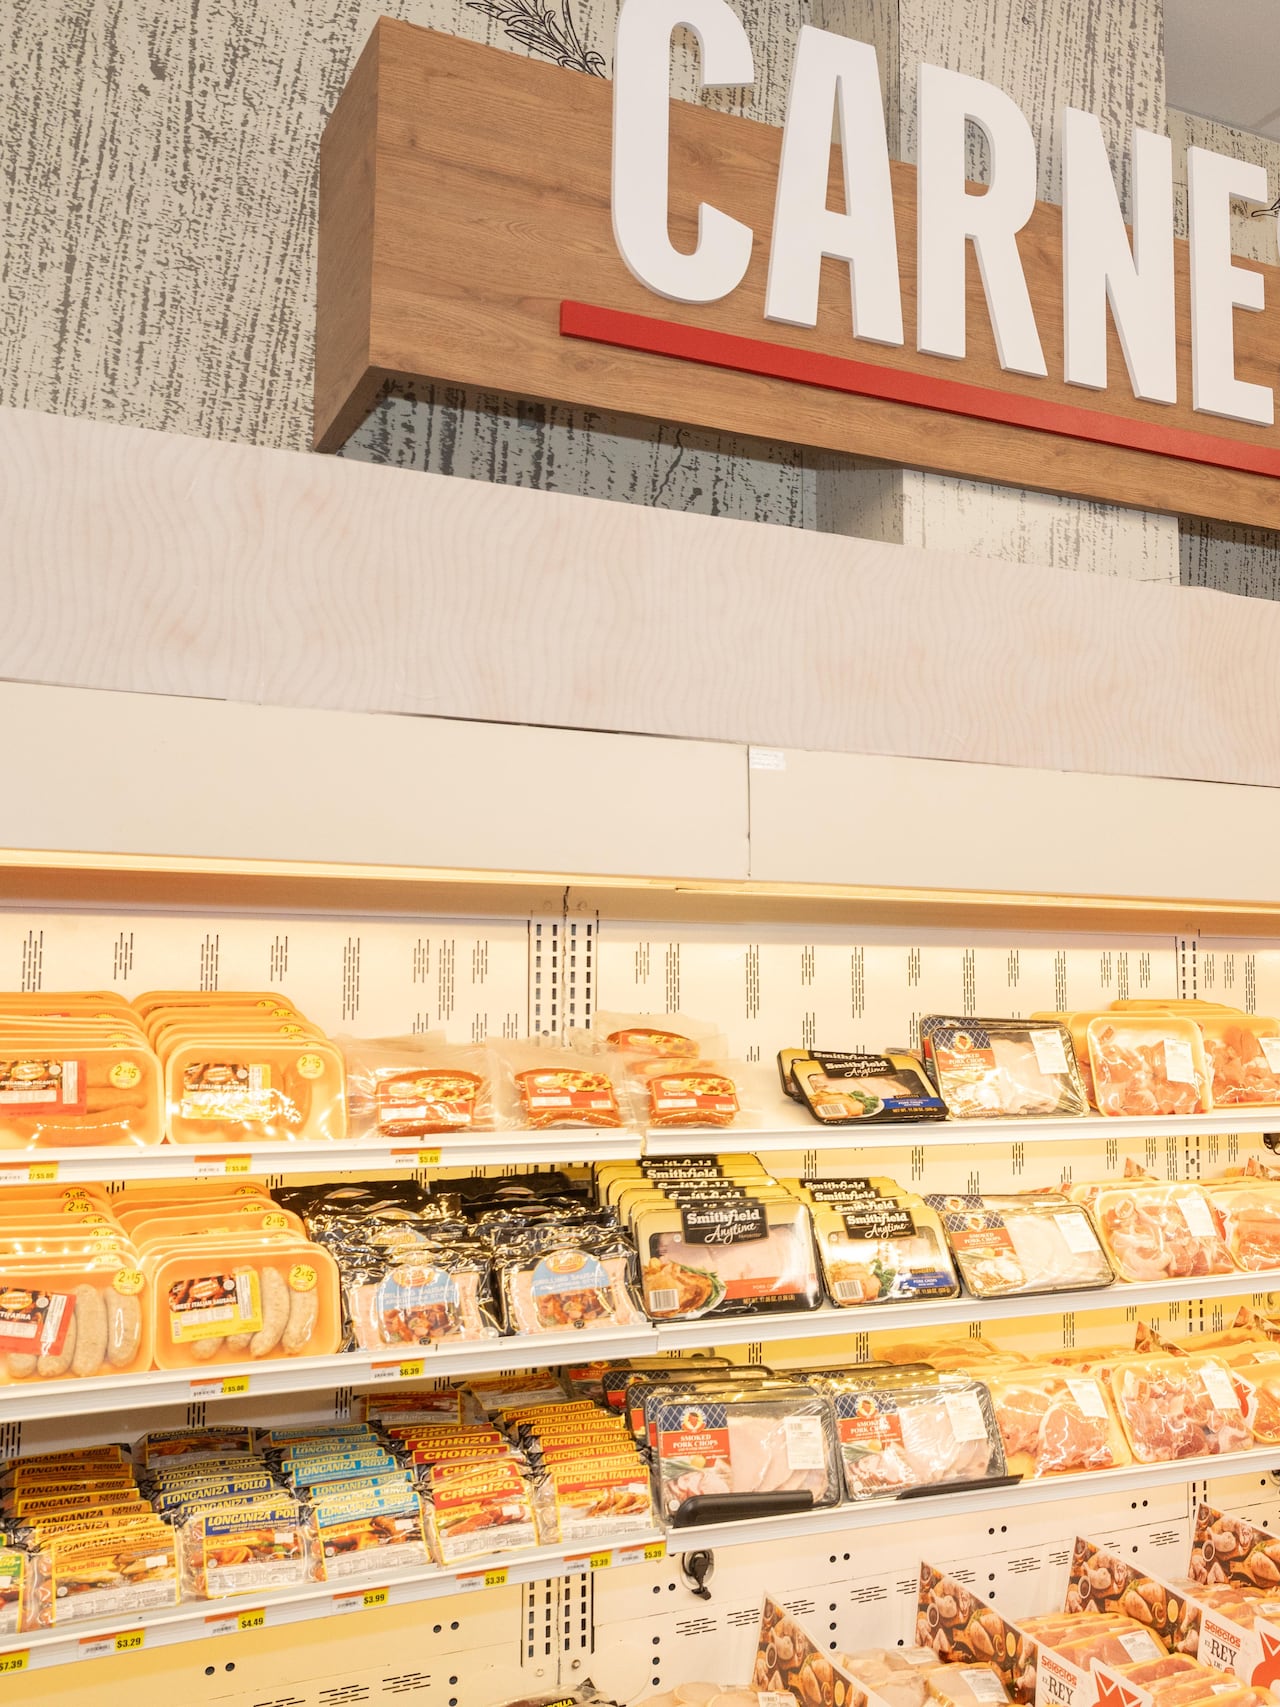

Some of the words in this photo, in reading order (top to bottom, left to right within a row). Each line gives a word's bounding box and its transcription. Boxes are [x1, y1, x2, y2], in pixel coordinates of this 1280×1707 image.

[825, 1060, 889, 1070] Smithfield
[845, 1066, 887, 1078] Anytime
[647, 1168, 718, 1179] Smithfield
[815, 1190, 876, 1201] Smithfield
[835, 1200, 896, 1212] Smithfield
[687, 1209, 762, 1227] Smithfield
[847, 1212, 910, 1226] Smithfield
[704, 1222, 758, 1245] Anytime
[864, 1223, 907, 1239] Anytime
[191, 1300, 212, 1308] ITALIAN
[213, 1296, 237, 1305] SAUSAGE
[399, 1367, 420, 1377] $6.39
[506, 1407, 556, 1420] SALCHICHA
[555, 1403, 593, 1414] ITALIANA
[535, 1423, 583, 1435] SALCHICHA
[584, 1418, 623, 1430] ITALIANA
[417, 1435, 492, 1449] CHORIZO
[544, 1435, 588, 1447] SALCHICHA
[588, 1432, 629, 1443] ITALIANA
[681, 1434, 712, 1442] SMOKED
[694, 1439, 719, 1448] CHOPS
[424, 1448, 499, 1461] CHORIZO
[546, 1448, 594, 1461] SALCHICHA
[595, 1443, 633, 1455] ITALIANA
[12, 1452, 75, 1467] LONGANIZA
[552, 1460, 600, 1472] SALCHICHA
[601, 1456, 639, 1468] ITALIANA
[21, 1464, 86, 1476] LONGANIZA
[298, 1461, 356, 1476] LONGANIZA
[559, 1471, 609, 1484] SALCHICHA
[609, 1467, 647, 1480] ITALIANA
[21, 1483, 87, 1496] LONGANIZA
[166, 1486, 229, 1505] LONGANIZA
[234, 1479, 267, 1491] POLLO
[316, 1479, 374, 1495] LONGANIZA
[440, 1480, 515, 1502] CHORIZO
[23, 1495, 91, 1510] LONGANIZA
[321, 1500, 380, 1518] LONGANIZA
[208, 1510, 271, 1527] LONGANIZA
[42, 1521, 110, 1535] LONGANIZA
[57, 1535, 127, 1553] LONGANIZA
[644, 1549, 663, 1559] $5.39
[590, 1557, 609, 1568] $3.39
[485, 1574, 505, 1586] $3.39
[363, 1594, 386, 1605] $3.99
[241, 1617, 265, 1628] $4.49
[1205, 1619, 1241, 1648] Selectos
[117, 1637, 142, 1649] $3.29
[1211, 1638, 1237, 1667] REY
[0, 1660, 23, 1671] $7.39
[1041, 1655, 1078, 1686] Selectos
[1049, 1675, 1075, 1706] REY
